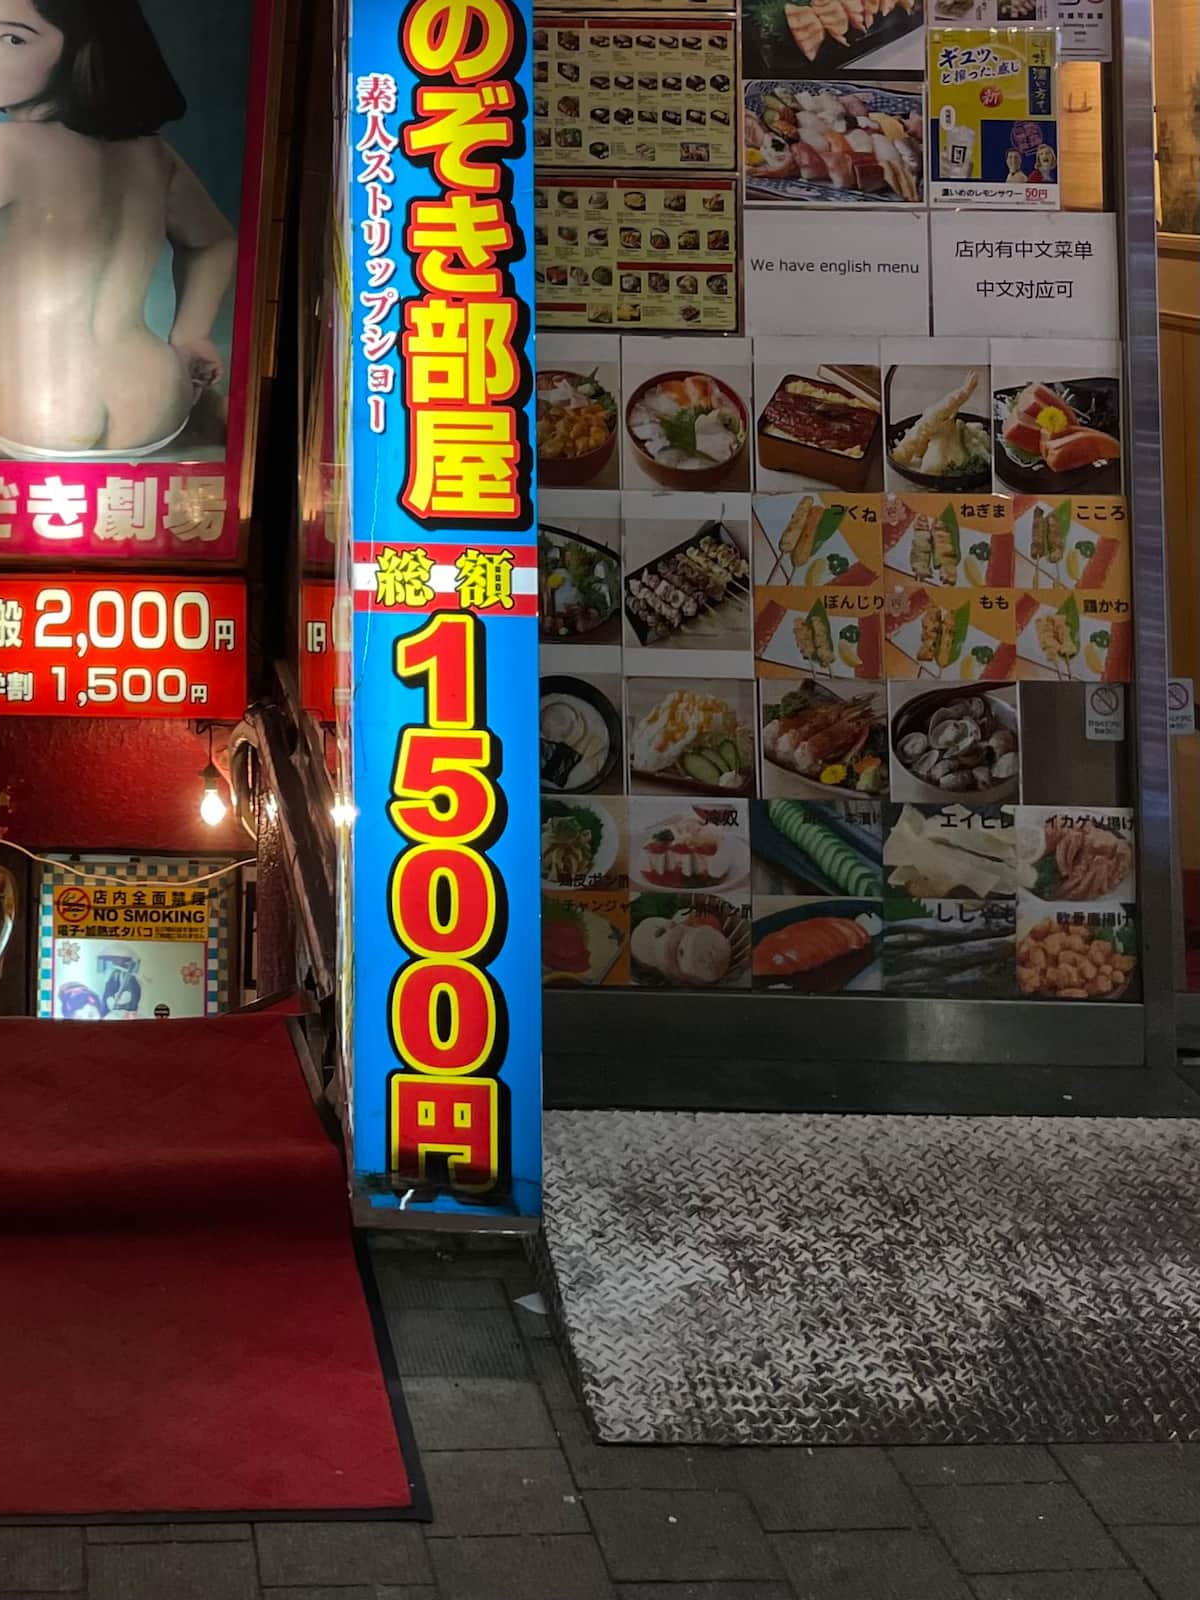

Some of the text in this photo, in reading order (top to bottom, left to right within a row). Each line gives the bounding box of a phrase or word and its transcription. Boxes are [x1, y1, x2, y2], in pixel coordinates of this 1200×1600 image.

[356, 73, 398, 434] 素人ストリップショー
[955, 240, 1094, 260] 店内有中文菜单
[750, 259, 920, 275] We have english menu
[976, 280, 1074, 300] 中文对应可
[830, 503, 879, 524] つくね
[959, 502, 1007, 520] ねぎま
[1075, 503, 1126, 521] こころ
[375, 547, 515, 611] 総額
[823, 593, 885, 612] ぼんじり
[978, 594, 1010, 611] もも
[33, 587, 237, 659] 2,000円
[50, 664, 209, 708] 1,500円
[940, 811, 1014, 830] エイヒレ
[93, 889, 206, 907] 店内全面禁煙
[386, 612, 502, 1193] 1500円
[94, 909, 205, 924] NO SMOKING
